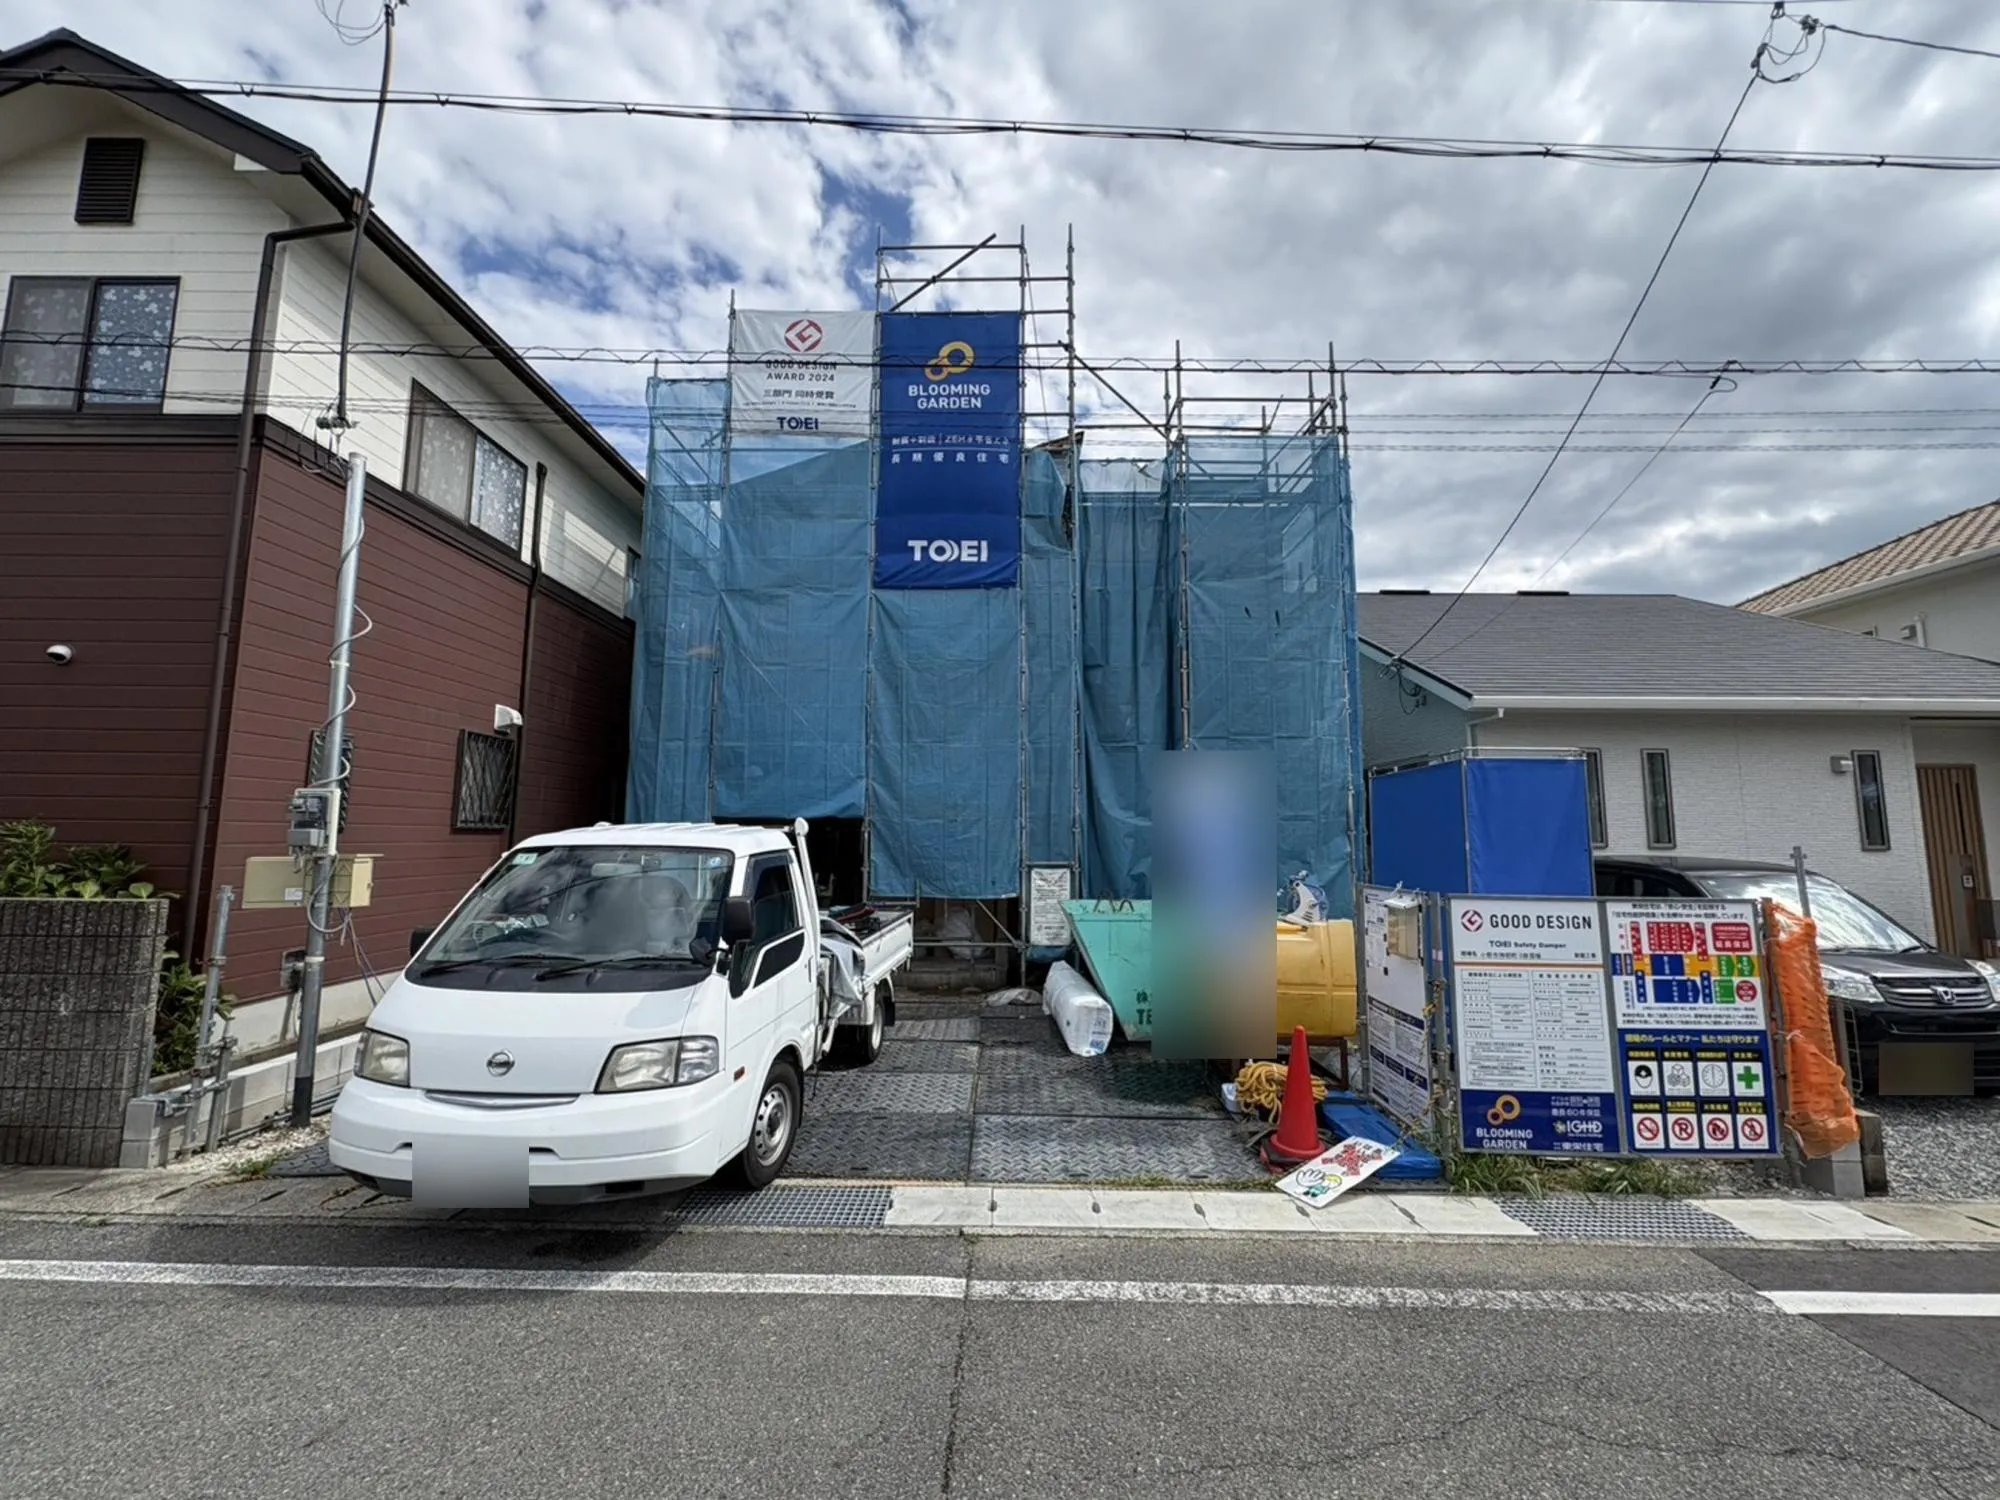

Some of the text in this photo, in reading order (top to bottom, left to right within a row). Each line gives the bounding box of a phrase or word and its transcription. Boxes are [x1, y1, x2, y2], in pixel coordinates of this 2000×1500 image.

[766, 373, 835, 382] AWARD 2024
[908, 384, 991, 397] BLOOMING
[916, 397, 982, 410] GARDEN
[777, 416, 819, 430] TOEI
[891, 451, 1009, 464] 長期優良住宅
[907, 539, 988, 563] TOEI
[1490, 914, 1592, 930] GOOD DESIGN
[1476, 1127, 1533, 1140] BLOOMING
[1482, 1138, 1527, 1150] GARDEN
